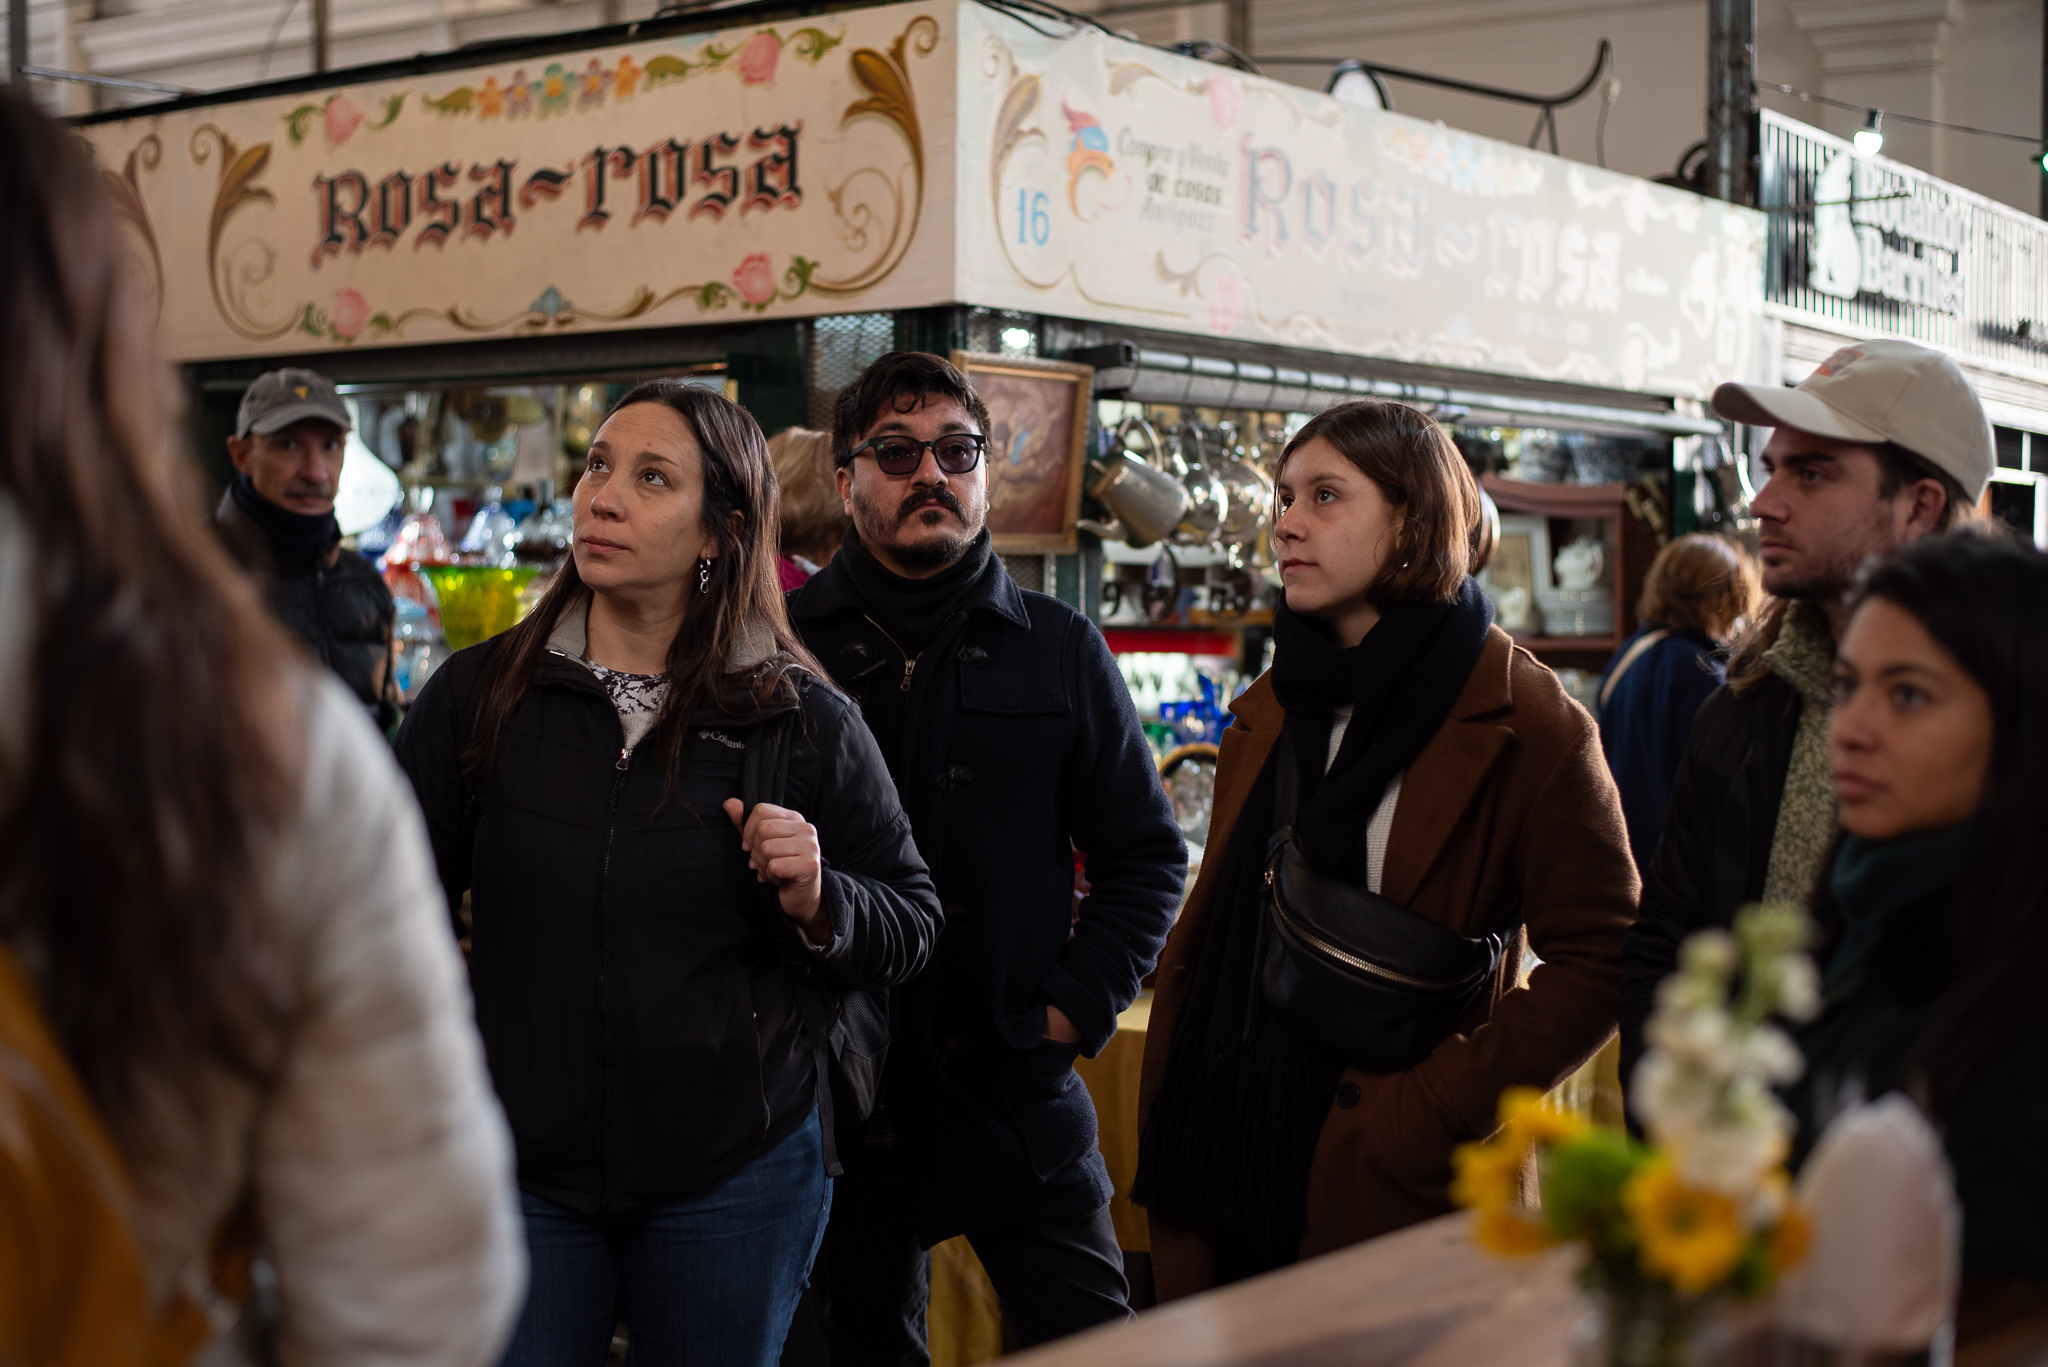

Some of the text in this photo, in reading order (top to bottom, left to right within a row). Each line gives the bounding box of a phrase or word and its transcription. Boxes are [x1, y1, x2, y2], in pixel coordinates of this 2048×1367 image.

[1177, 149, 1188, 175] y
[1146, 167, 1167, 194] de
[1017, 187, 1051, 246] 16
[710, 731, 746, 749] Columb
